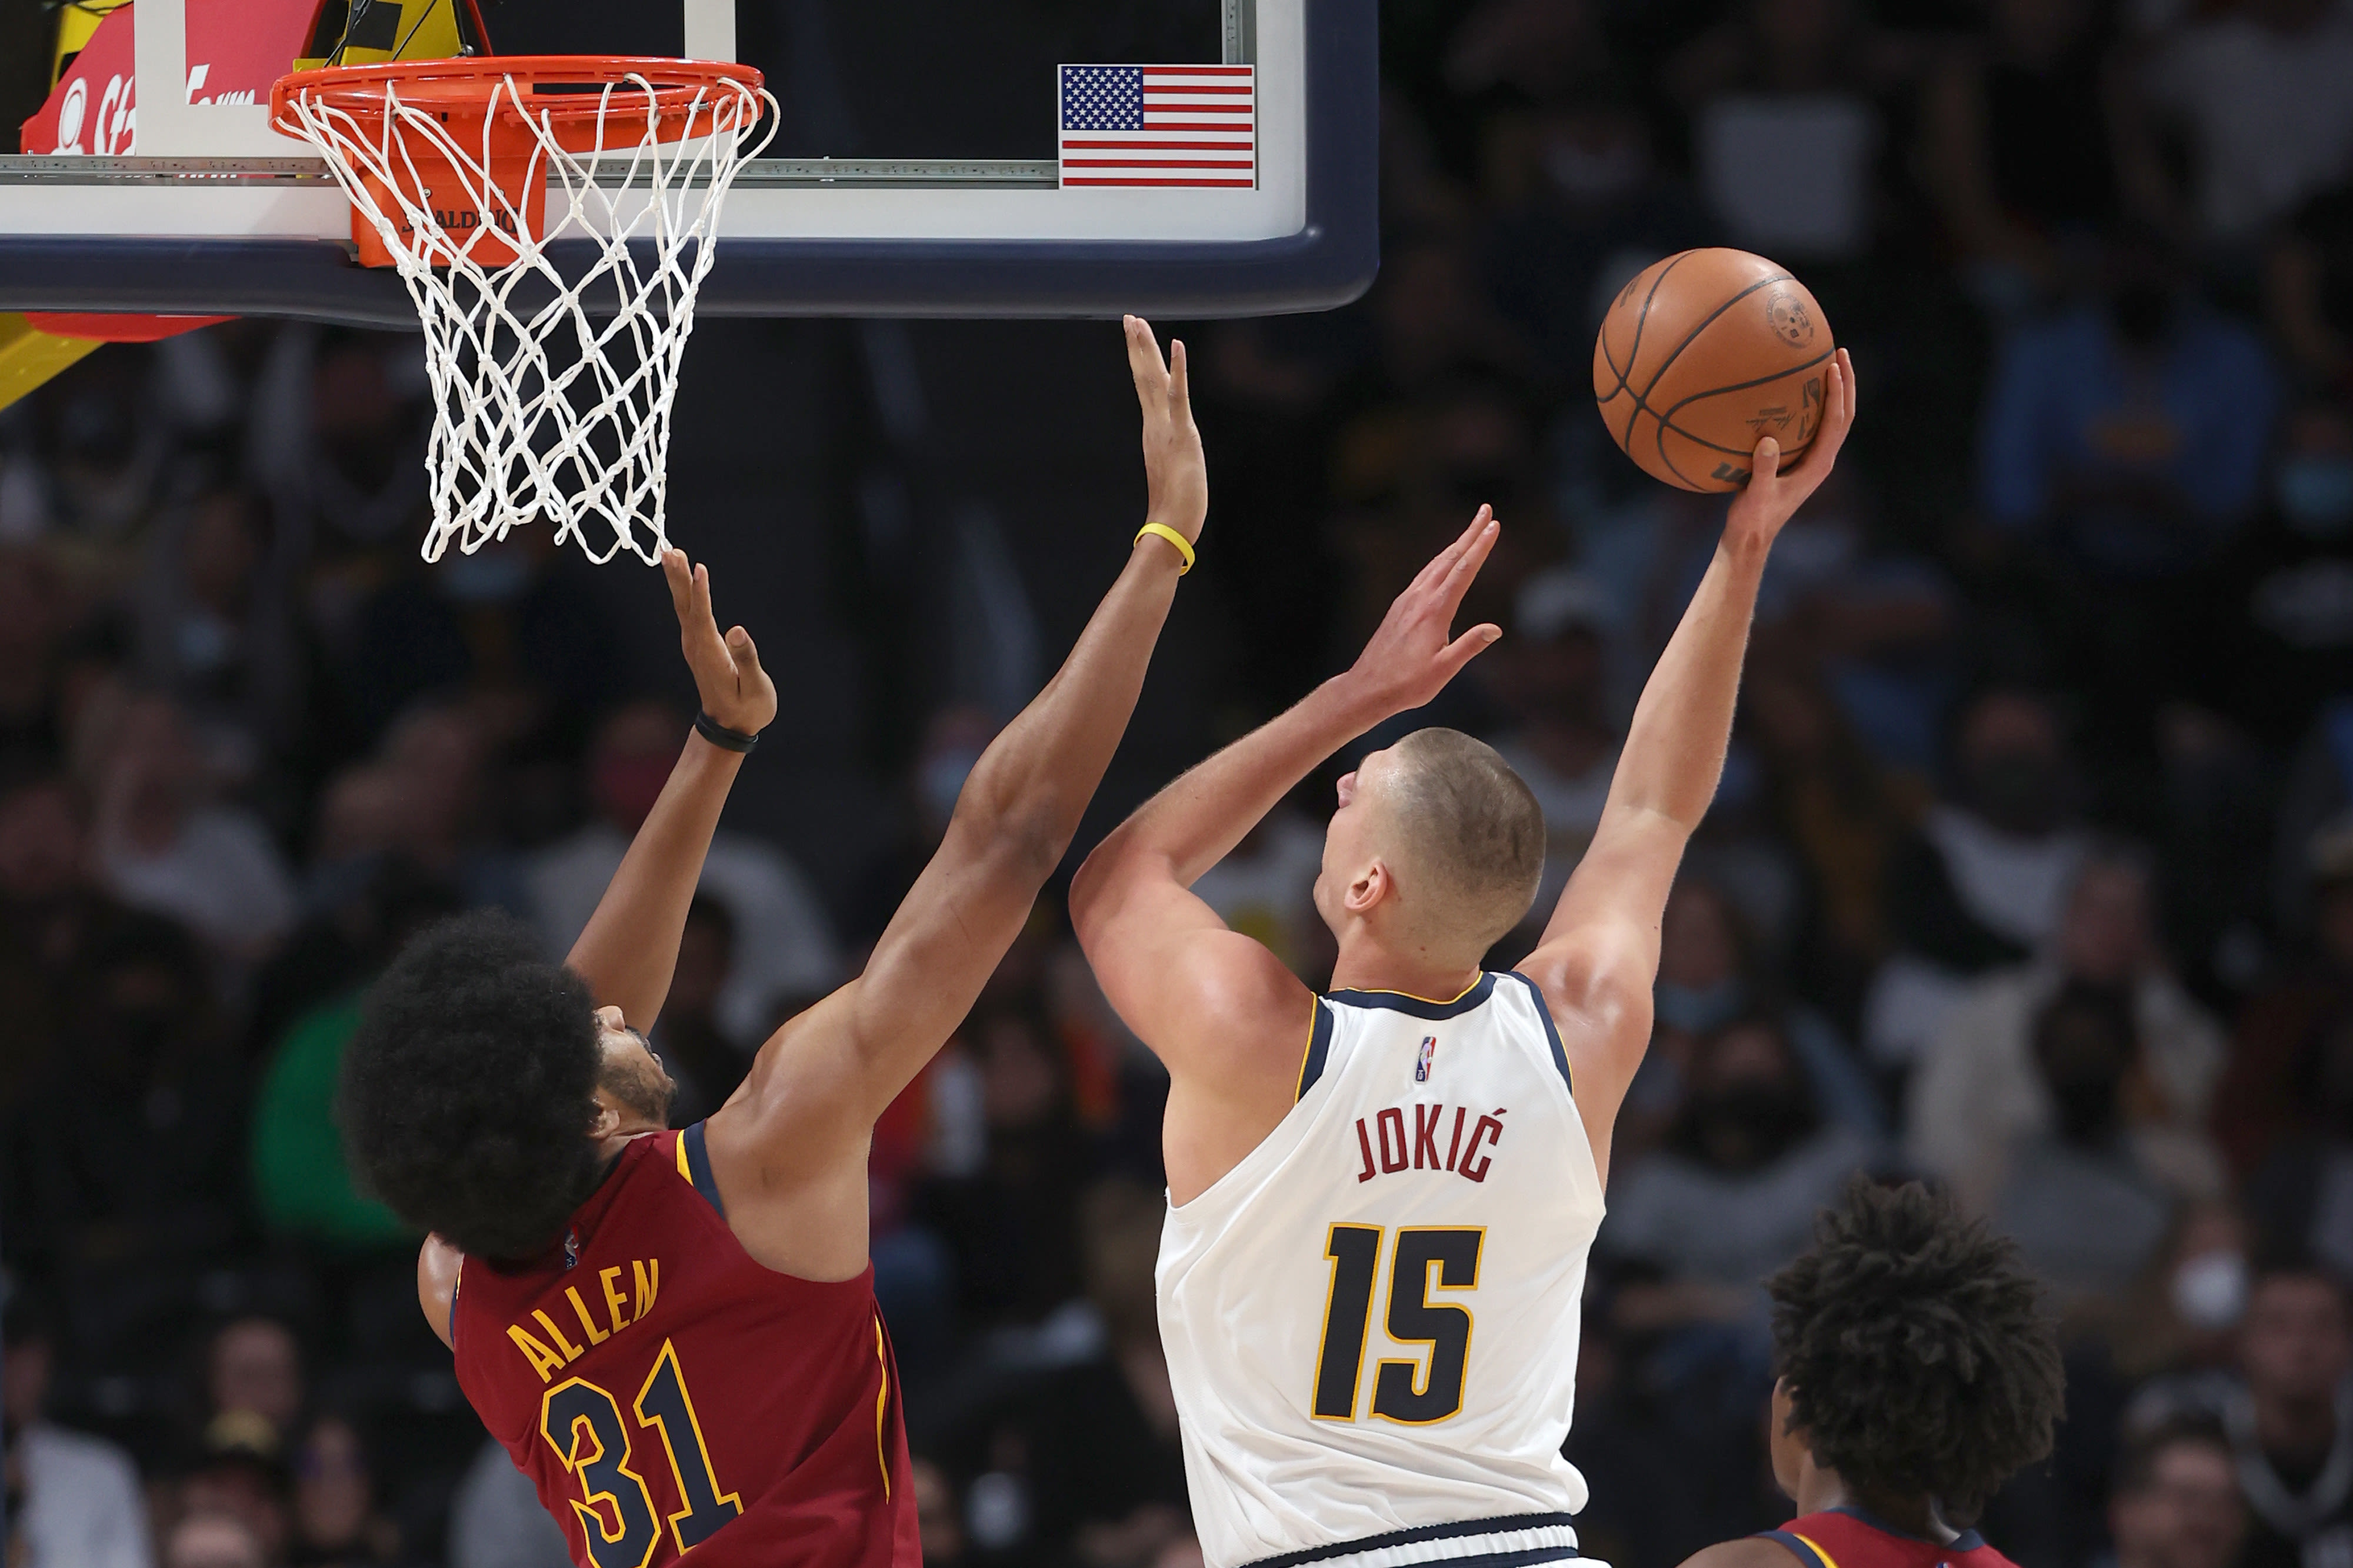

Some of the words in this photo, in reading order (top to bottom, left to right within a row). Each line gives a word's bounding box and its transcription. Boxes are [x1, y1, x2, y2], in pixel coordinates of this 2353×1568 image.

[402, 206, 519, 234] ALDG
[1356, 1104, 1507, 1183] JOKIĆ
[506, 1259, 659, 1383] ALLEN
[1311, 1222, 1488, 1427] 15
[540, 1337, 745, 1568] 31
